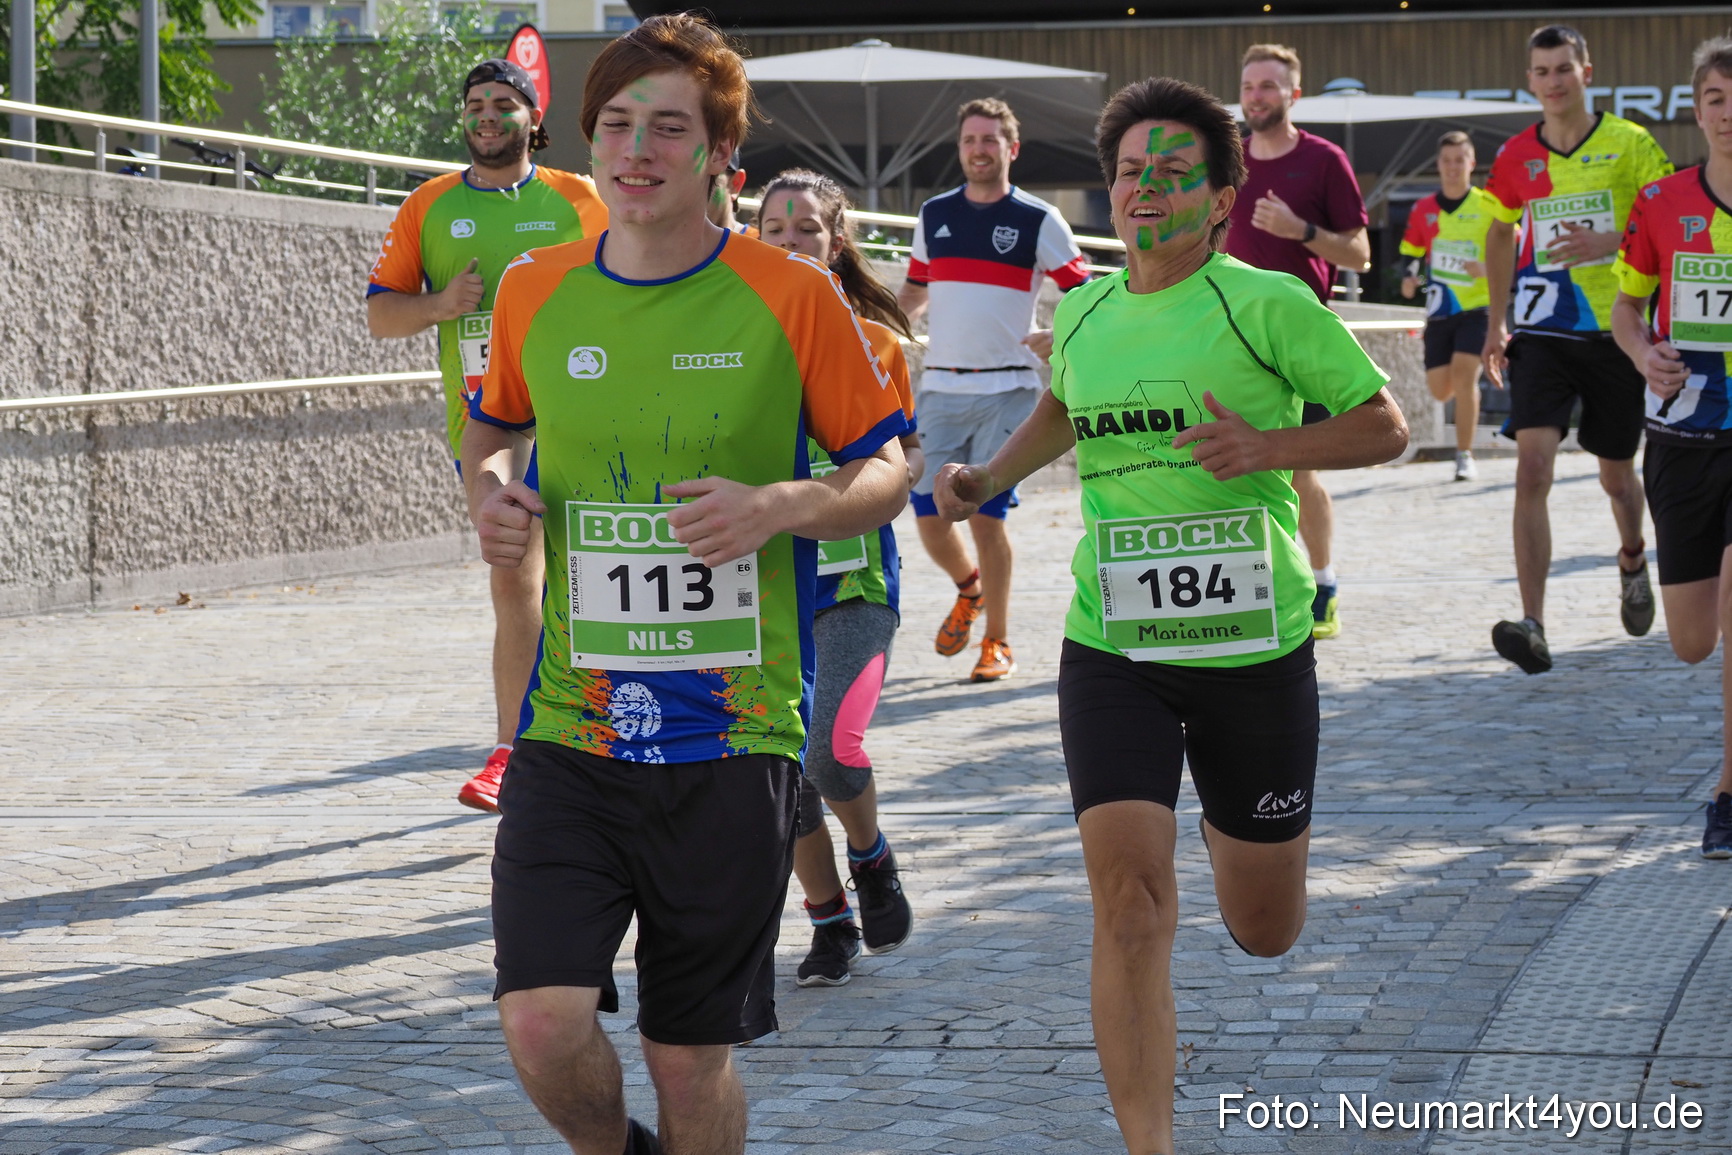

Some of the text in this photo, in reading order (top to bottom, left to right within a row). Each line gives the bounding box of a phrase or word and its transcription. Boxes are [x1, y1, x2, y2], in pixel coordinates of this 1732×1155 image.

[1535, 194, 1606, 219] BOCK
[515, 221, 556, 232] BOCK
[1523, 284, 1546, 321] 7
[672, 352, 743, 369] BOCK
[1093, 403, 1104, 411] und
[1104, 400, 1143, 409] Planungsbüro
[1109, 515, 1255, 557] BOCK
[607, 563, 714, 612] 113
[1137, 563, 1236, 609] 184
[628, 630, 694, 650] NILS
[1138, 622, 1243, 642] Marianne
